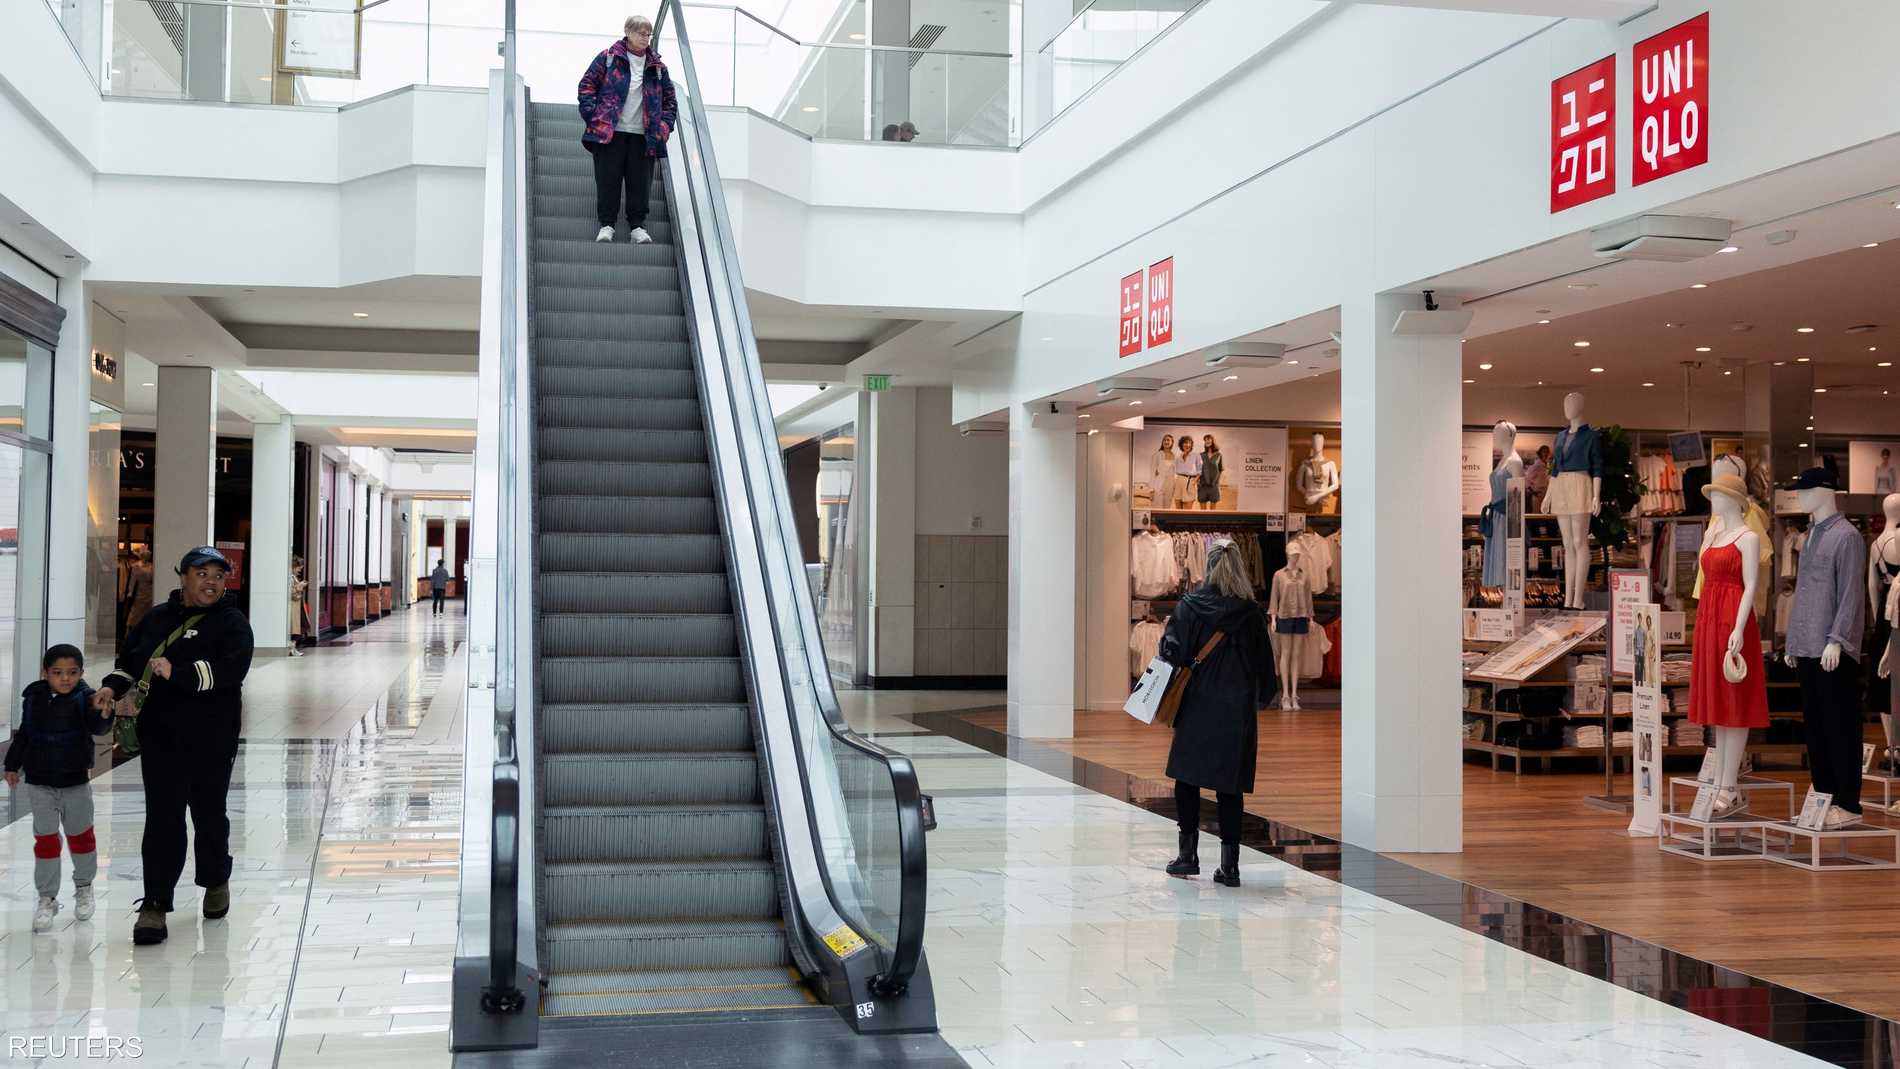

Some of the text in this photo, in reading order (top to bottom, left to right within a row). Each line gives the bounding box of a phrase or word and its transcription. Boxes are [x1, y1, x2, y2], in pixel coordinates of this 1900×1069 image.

[1642, 39, 1693, 105] UNI
[1560, 78, 1607, 138] ユニ
[1641, 100, 1699, 171] QLO
[1557, 135, 1607, 194] クロ
[1123, 282, 1140, 313] ユニ
[1151, 269, 1169, 303] UNI
[1121, 316, 1140, 347] クロ
[1150, 304, 1170, 341] QLO
[867, 376, 888, 390] EXIT
[183, 629, 198, 639] P
[858, 1003, 874, 1017] 35
